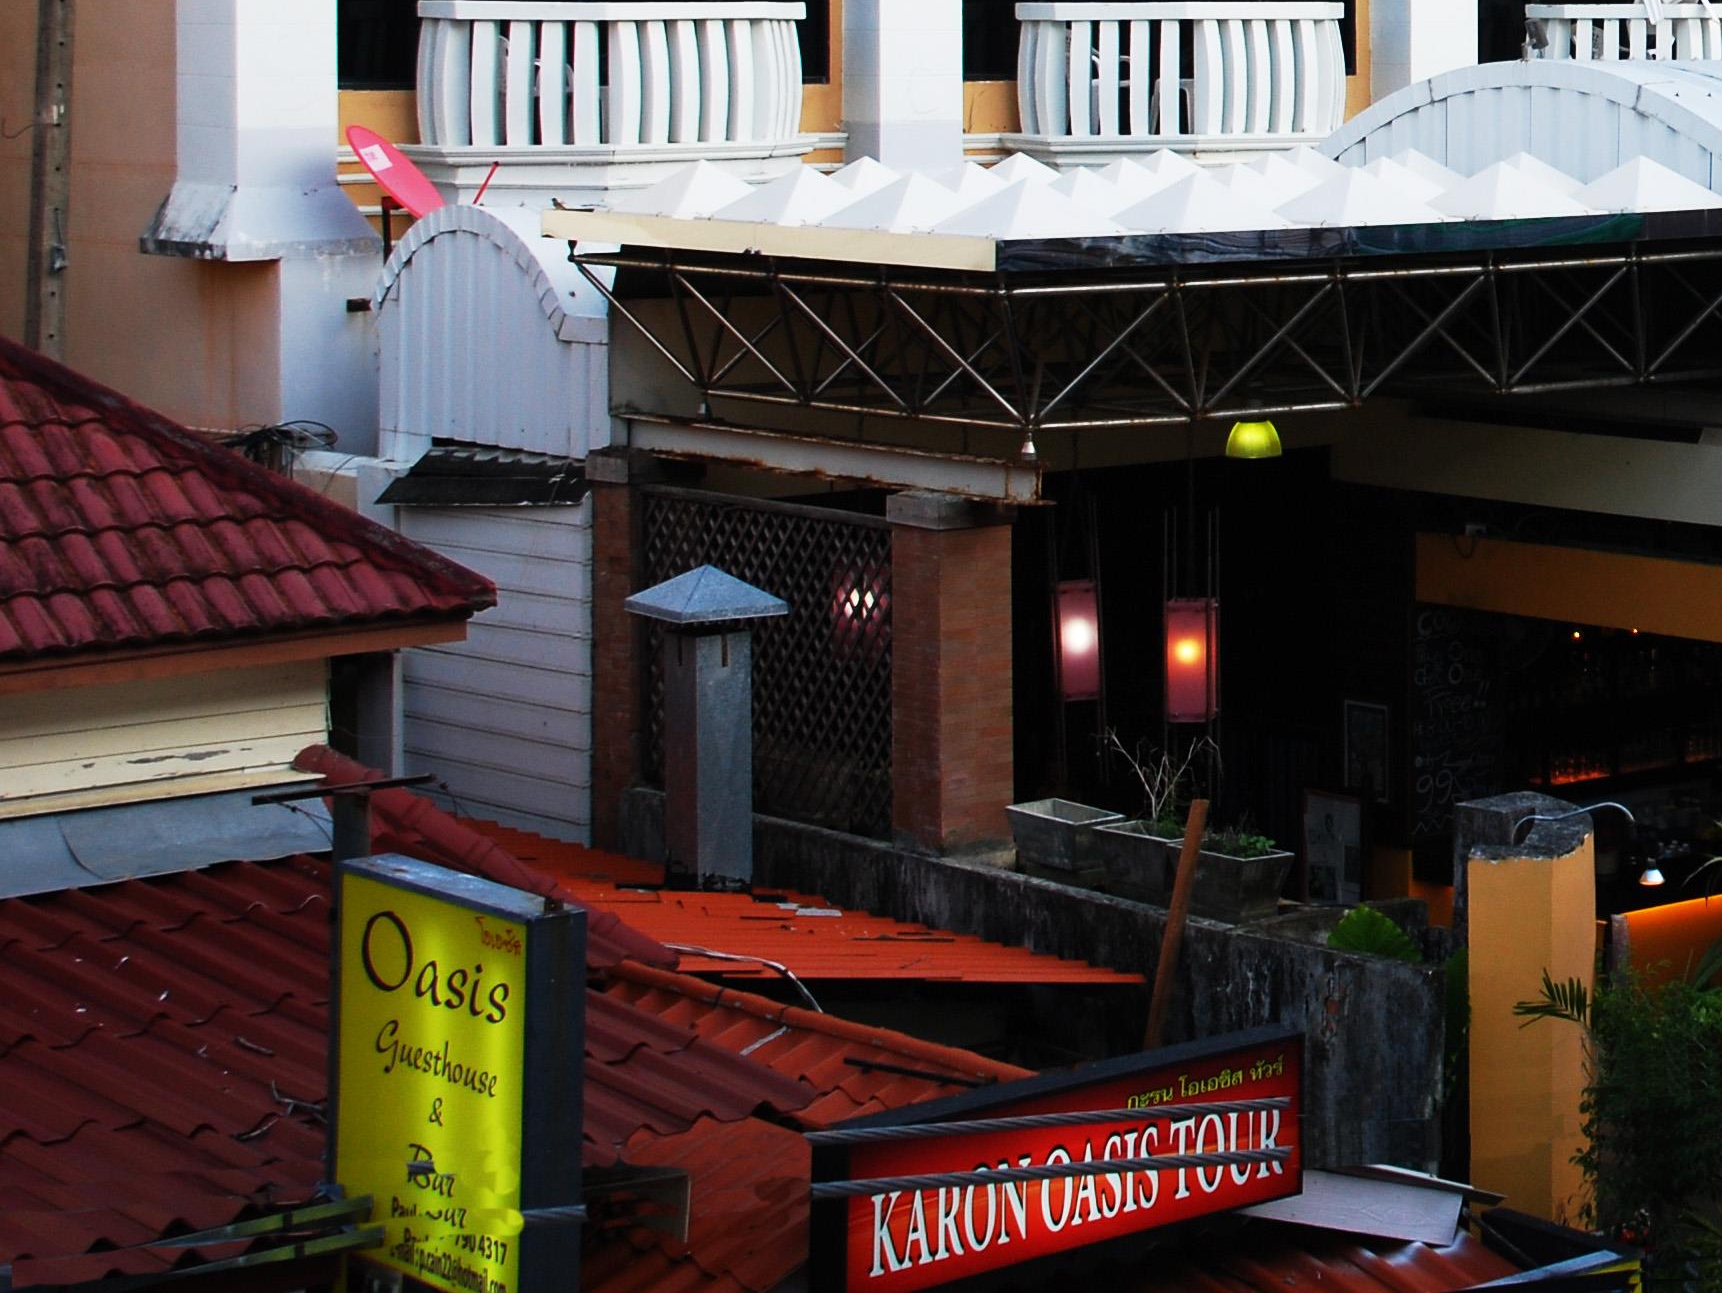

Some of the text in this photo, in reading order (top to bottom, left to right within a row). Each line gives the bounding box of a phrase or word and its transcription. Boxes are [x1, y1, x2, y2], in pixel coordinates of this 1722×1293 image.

[361, 910, 511, 1025] Oasis
[375, 1019, 498, 1099] Guesthouse
[428, 1096, 444, 1128] &
[869, 1109, 1284, 1278] KARON OASIS TOUR
